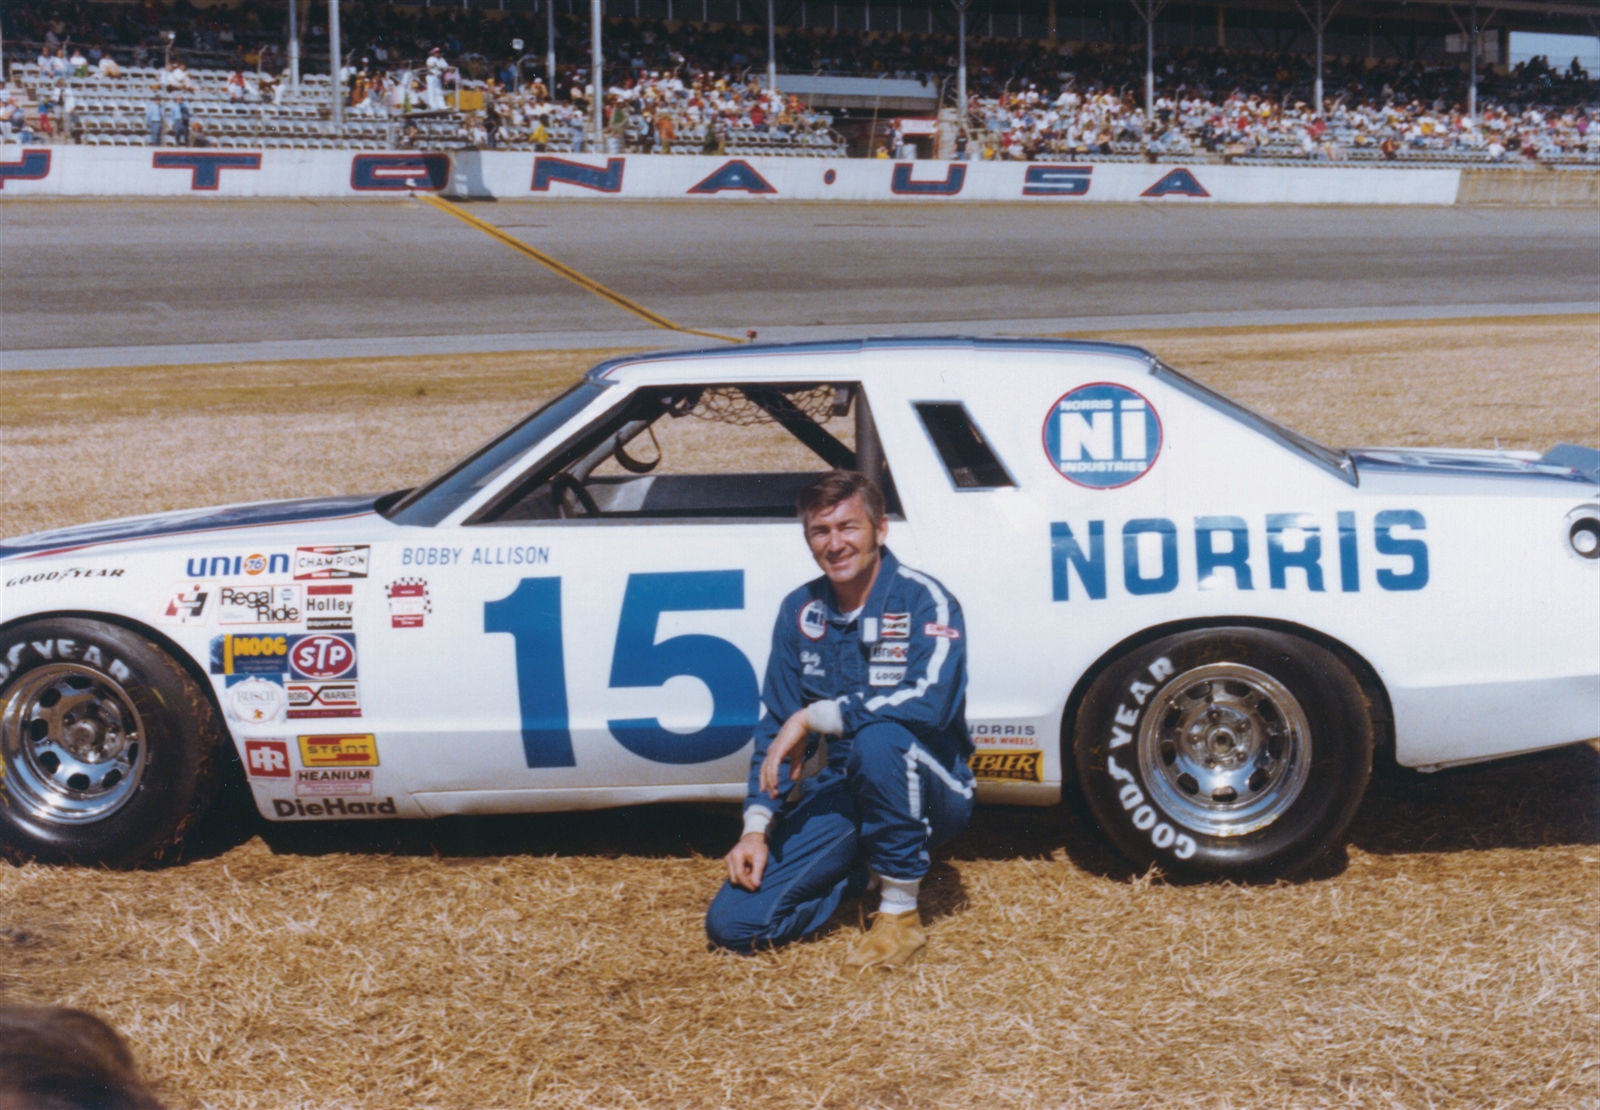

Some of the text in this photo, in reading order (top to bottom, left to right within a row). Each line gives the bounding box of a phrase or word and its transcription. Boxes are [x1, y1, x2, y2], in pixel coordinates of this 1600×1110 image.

[1060, 399, 1114, 411] NORRIS
[1060, 461, 1148, 472] INDUSTRIES
[298, 556, 366, 568] CHAMPION
[402, 546, 550, 565] BOBBY ALLISON
[1050, 509, 1430, 602] NORRIS
[220, 587, 275, 609] Regal
[306, 597, 354, 614] Holley
[256, 603, 299, 622] Ride
[233, 636, 288, 656] MOOG
[298, 638, 347, 670] STP
[483, 568, 761, 769] 15
[298, 770, 370, 781] HEANIUM
[272, 796, 398, 818] DieHard
